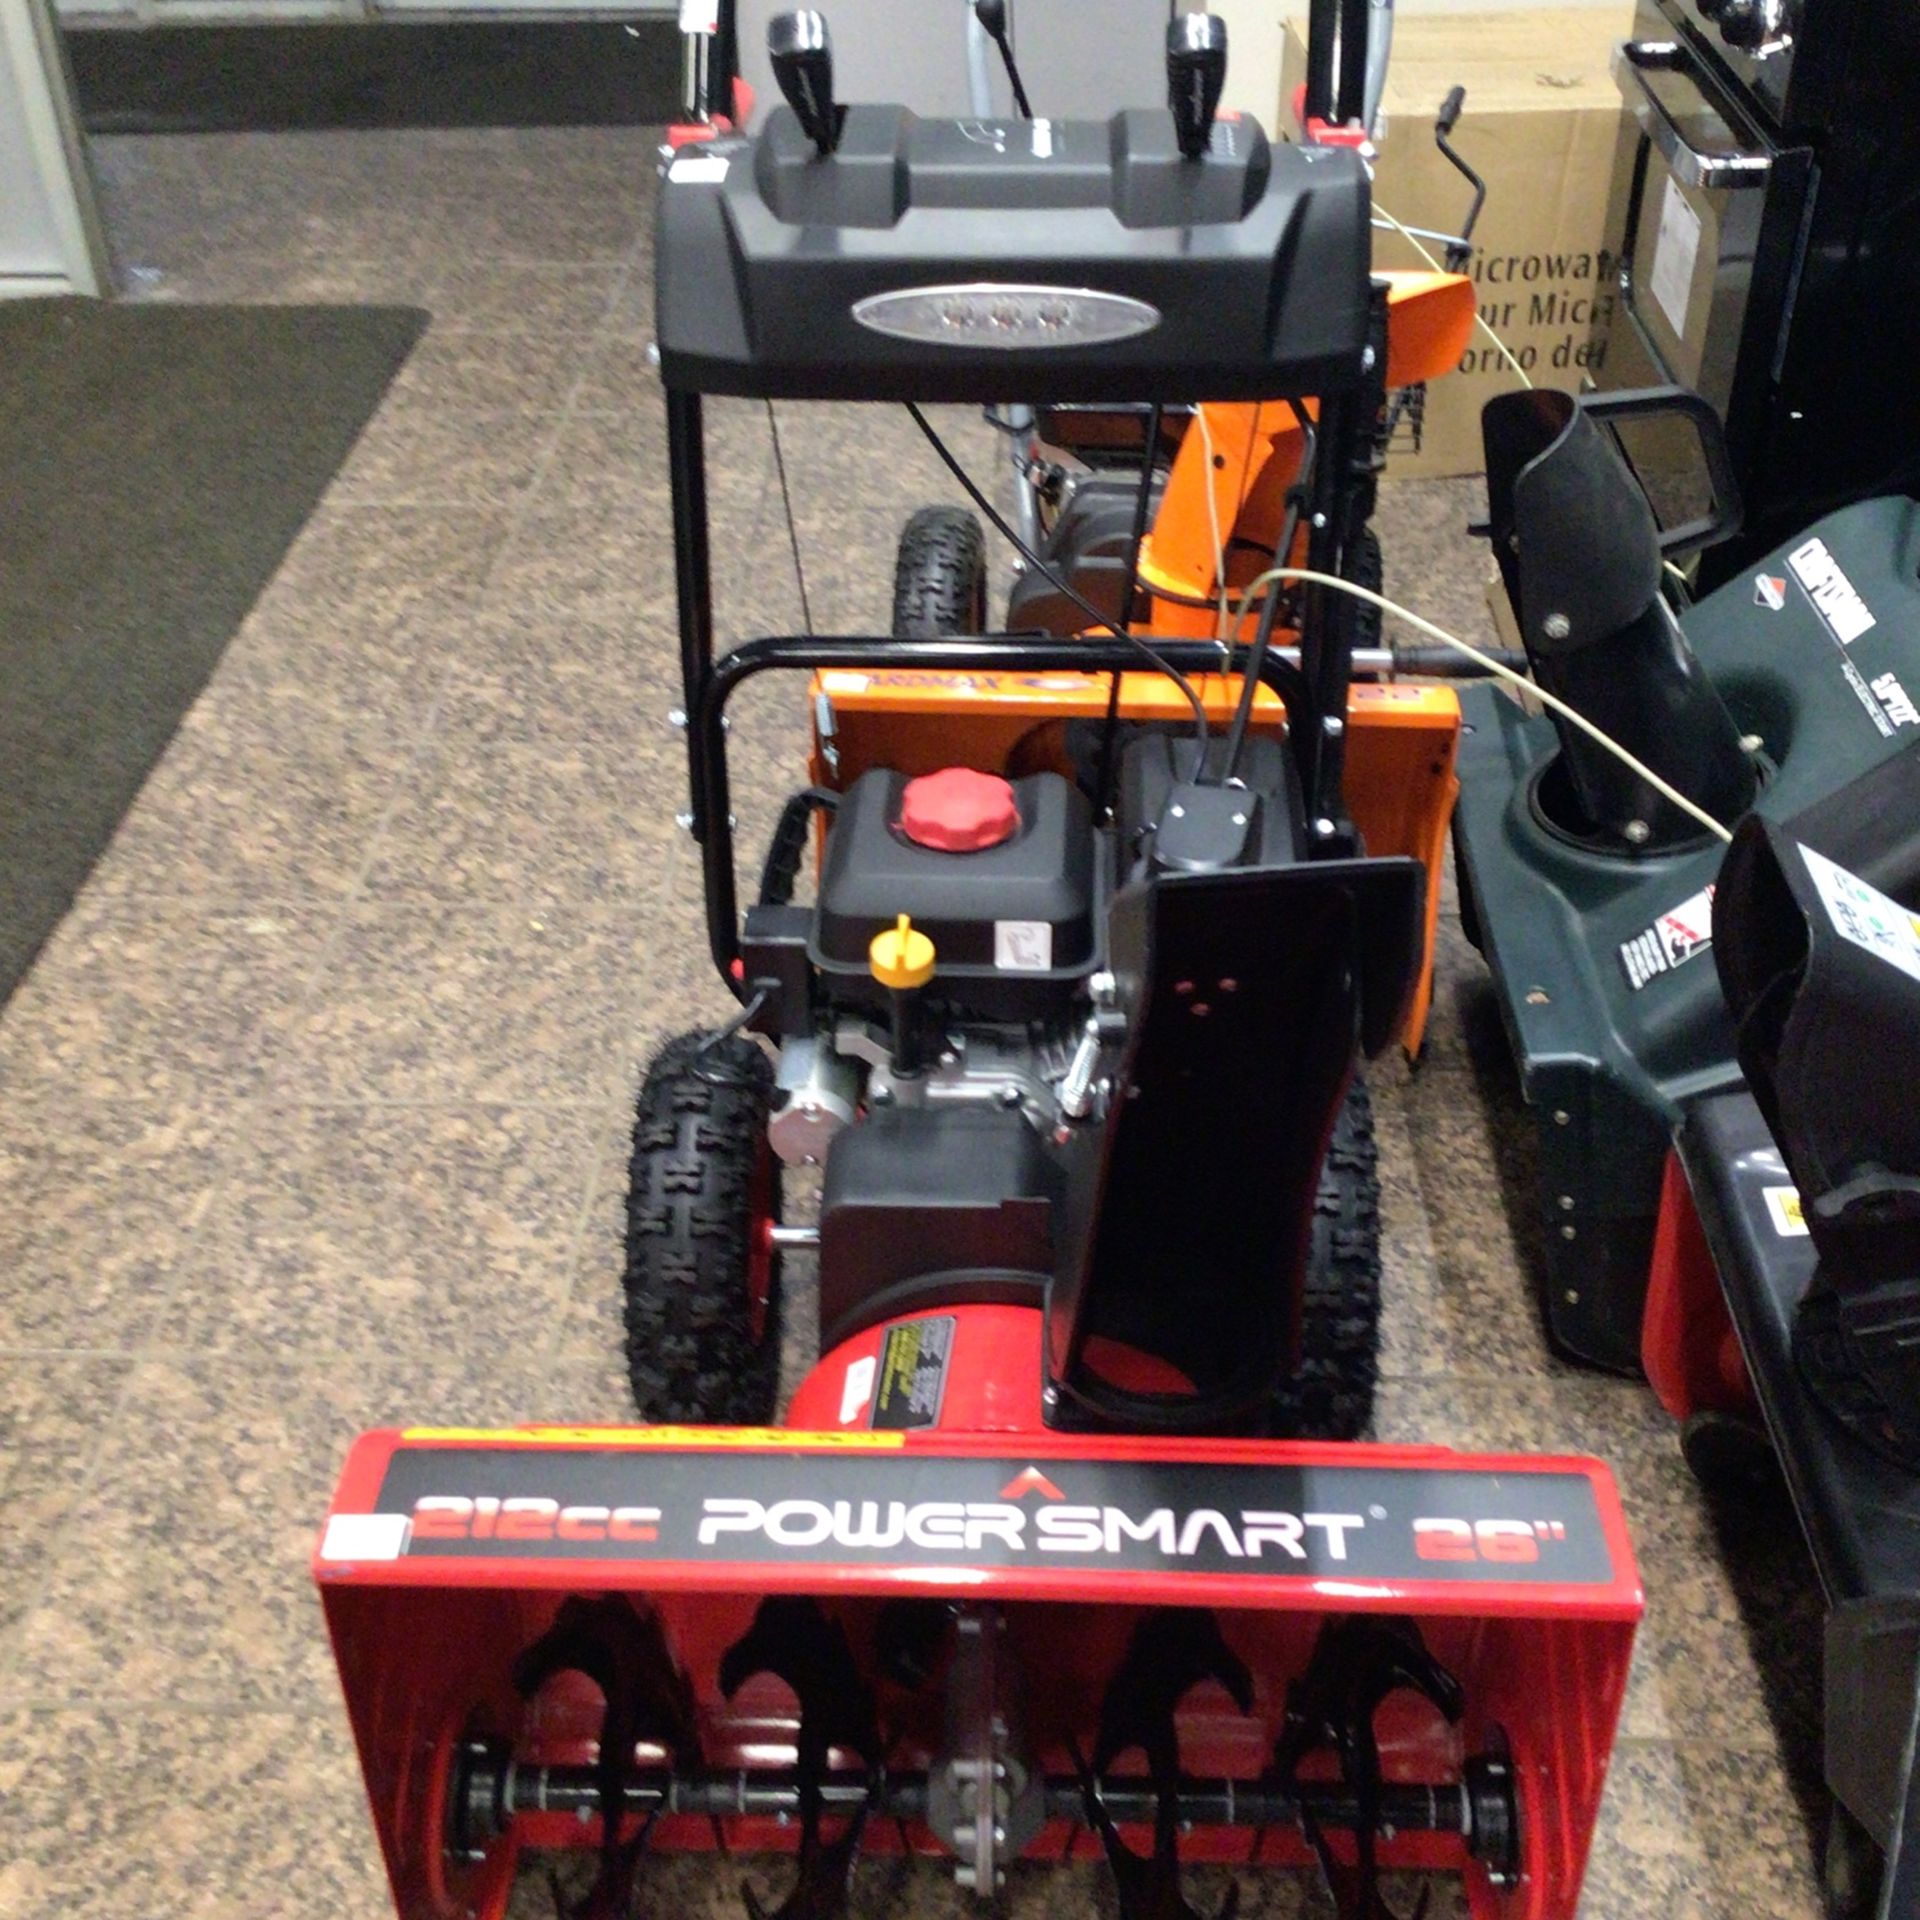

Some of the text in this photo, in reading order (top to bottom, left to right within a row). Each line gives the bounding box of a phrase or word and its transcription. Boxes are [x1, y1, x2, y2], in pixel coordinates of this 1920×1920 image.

[411, 1496, 1566, 1562] 212cc POWERSMART 26"
